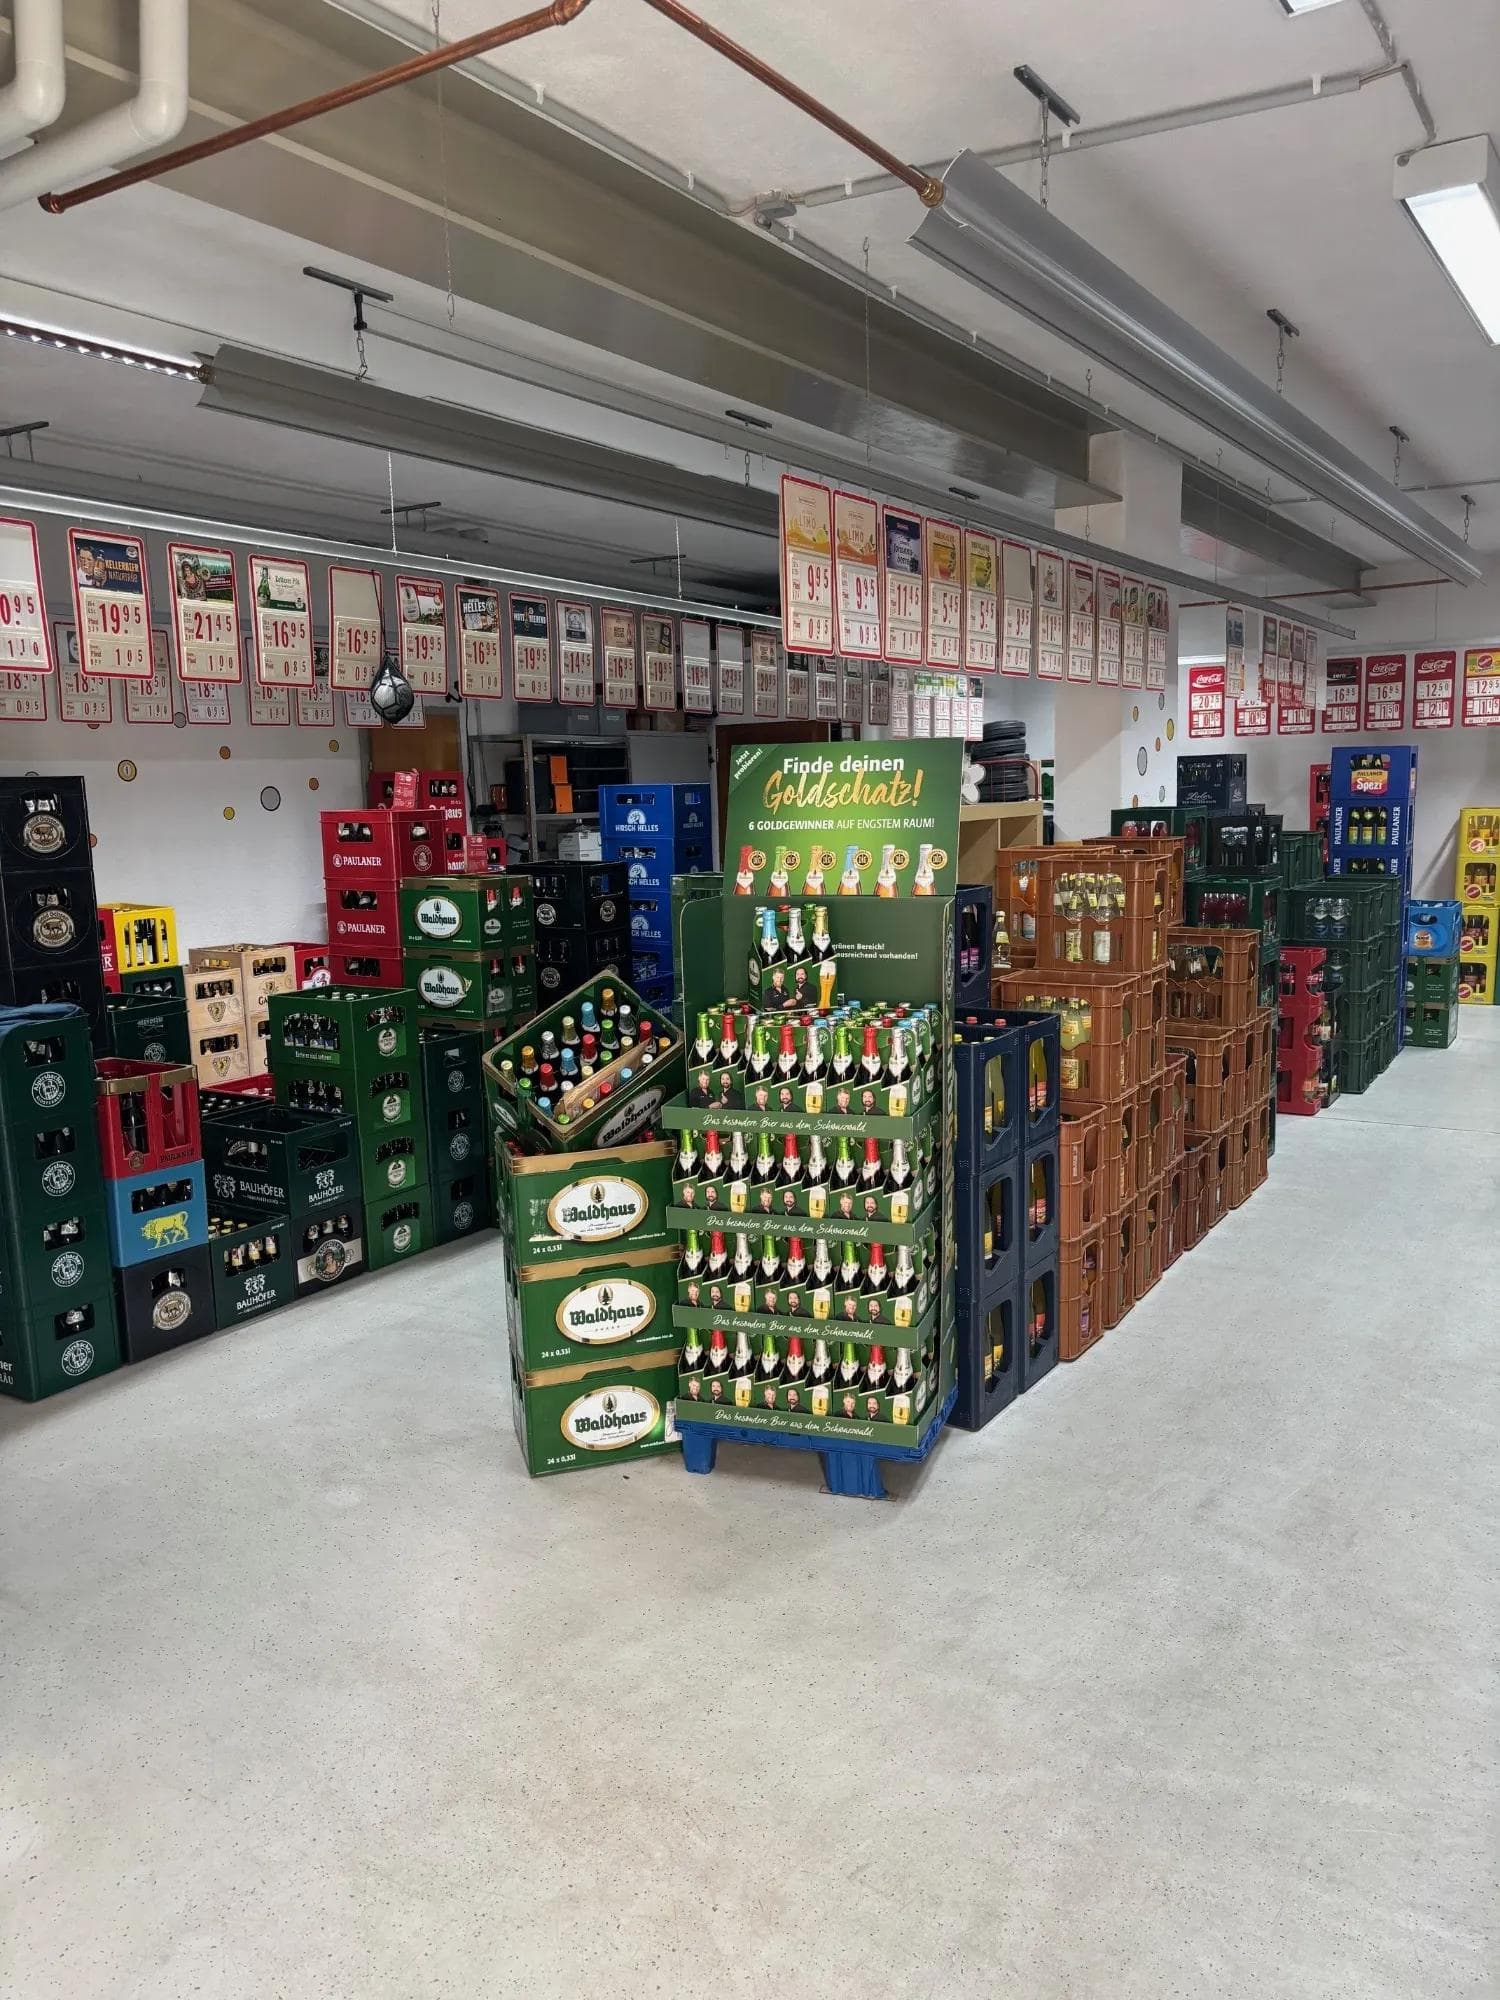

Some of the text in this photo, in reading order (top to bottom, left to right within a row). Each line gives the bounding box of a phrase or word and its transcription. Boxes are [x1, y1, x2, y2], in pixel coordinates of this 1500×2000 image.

[848, 528, 864, 542] LIMO
[808, 565, 828, 601] 9.95
[856, 577, 875, 610] 9.95
[463, 602, 486, 613] HELLES
[99, 603, 141, 634] 19.95
[194, 612, 232, 642] 21.45
[808, 618, 828, 639] 0.95
[272, 621, 305, 648] 16.95
[347, 628, 376, 654] 16.95
[415, 635, 442, 660] 19.95
[473, 641, 497, 664] 16.95
[524, 647, 547, 670] 19.95
[1376, 687, 1399, 700] 16.95
[1425, 683, 1449, 697] 12.50
[734, 748, 763, 780] probieren!
[735, 750, 750, 766] Jetzt
[783, 754, 904, 774] Finde deinen
[762, 767, 924, 815] Goldschatz!
[1356, 778, 1382, 791] Spezi
[615, 824, 659, 832] HIRSCH HELLES
[748, 818, 935, 831] 6 GOLDGEWINNER AUF ENGSTEM RAUM!
[1334, 806, 1343, 845] PAULANER
[1392, 806, 1401, 845] PAULANER
[343, 856, 382, 867] PAULANER
[639, 878, 660, 886] HELLES
[347, 922, 385, 935] PAULANER
[420, 913, 456, 926] Waldhaus
[641, 930, 662, 938] HELLES
[856, 942, 884, 950] Bereich!
[879, 951, 918, 960] vorhanden!
[33, 1072, 63, 1092] Alpirsbacher
[602, 1098, 658, 1142] Waldhaus
[703, 1115, 720, 1126] Das
[723, 1115, 757, 1127] besondere
[760, 1118, 778, 1129] Bier
[796, 1120, 812, 1130] dem
[814, 1119, 867, 1133] Schwarzwald
[239, 1180, 285, 1198] BAUHÖFER
[308, 1184, 344, 1203] BAUHÖFER
[562, 1203, 636, 1223] Waldhaus
[706, 1216, 724, 1227] Das
[726, 1217, 760, 1229] besondere
[763, 1220, 780, 1230] Bier
[798, 1223, 814, 1232] dem
[817, 1224, 869, 1237] Schwarzwald
[236, 1289, 276, 1310] BAUHÖFER
[569, 1305, 644, 1326] Waldhaus
[712, 1315, 730, 1326] Das
[732, 1315, 766, 1329] besondere
[769, 1320, 787, 1331] Bier
[803, 1324, 820, 1335] dem
[821, 1325, 873, 1339] Schwarzwald
[574, 1410, 647, 1433] Waldhaus
[714, 1410, 731, 1421] Das
[733, 1411, 768, 1425] besondere
[770, 1415, 788, 1427] Bier
[804, 1420, 820, 1430] dem
[822, 1422, 873, 1437] Schwarzwald
